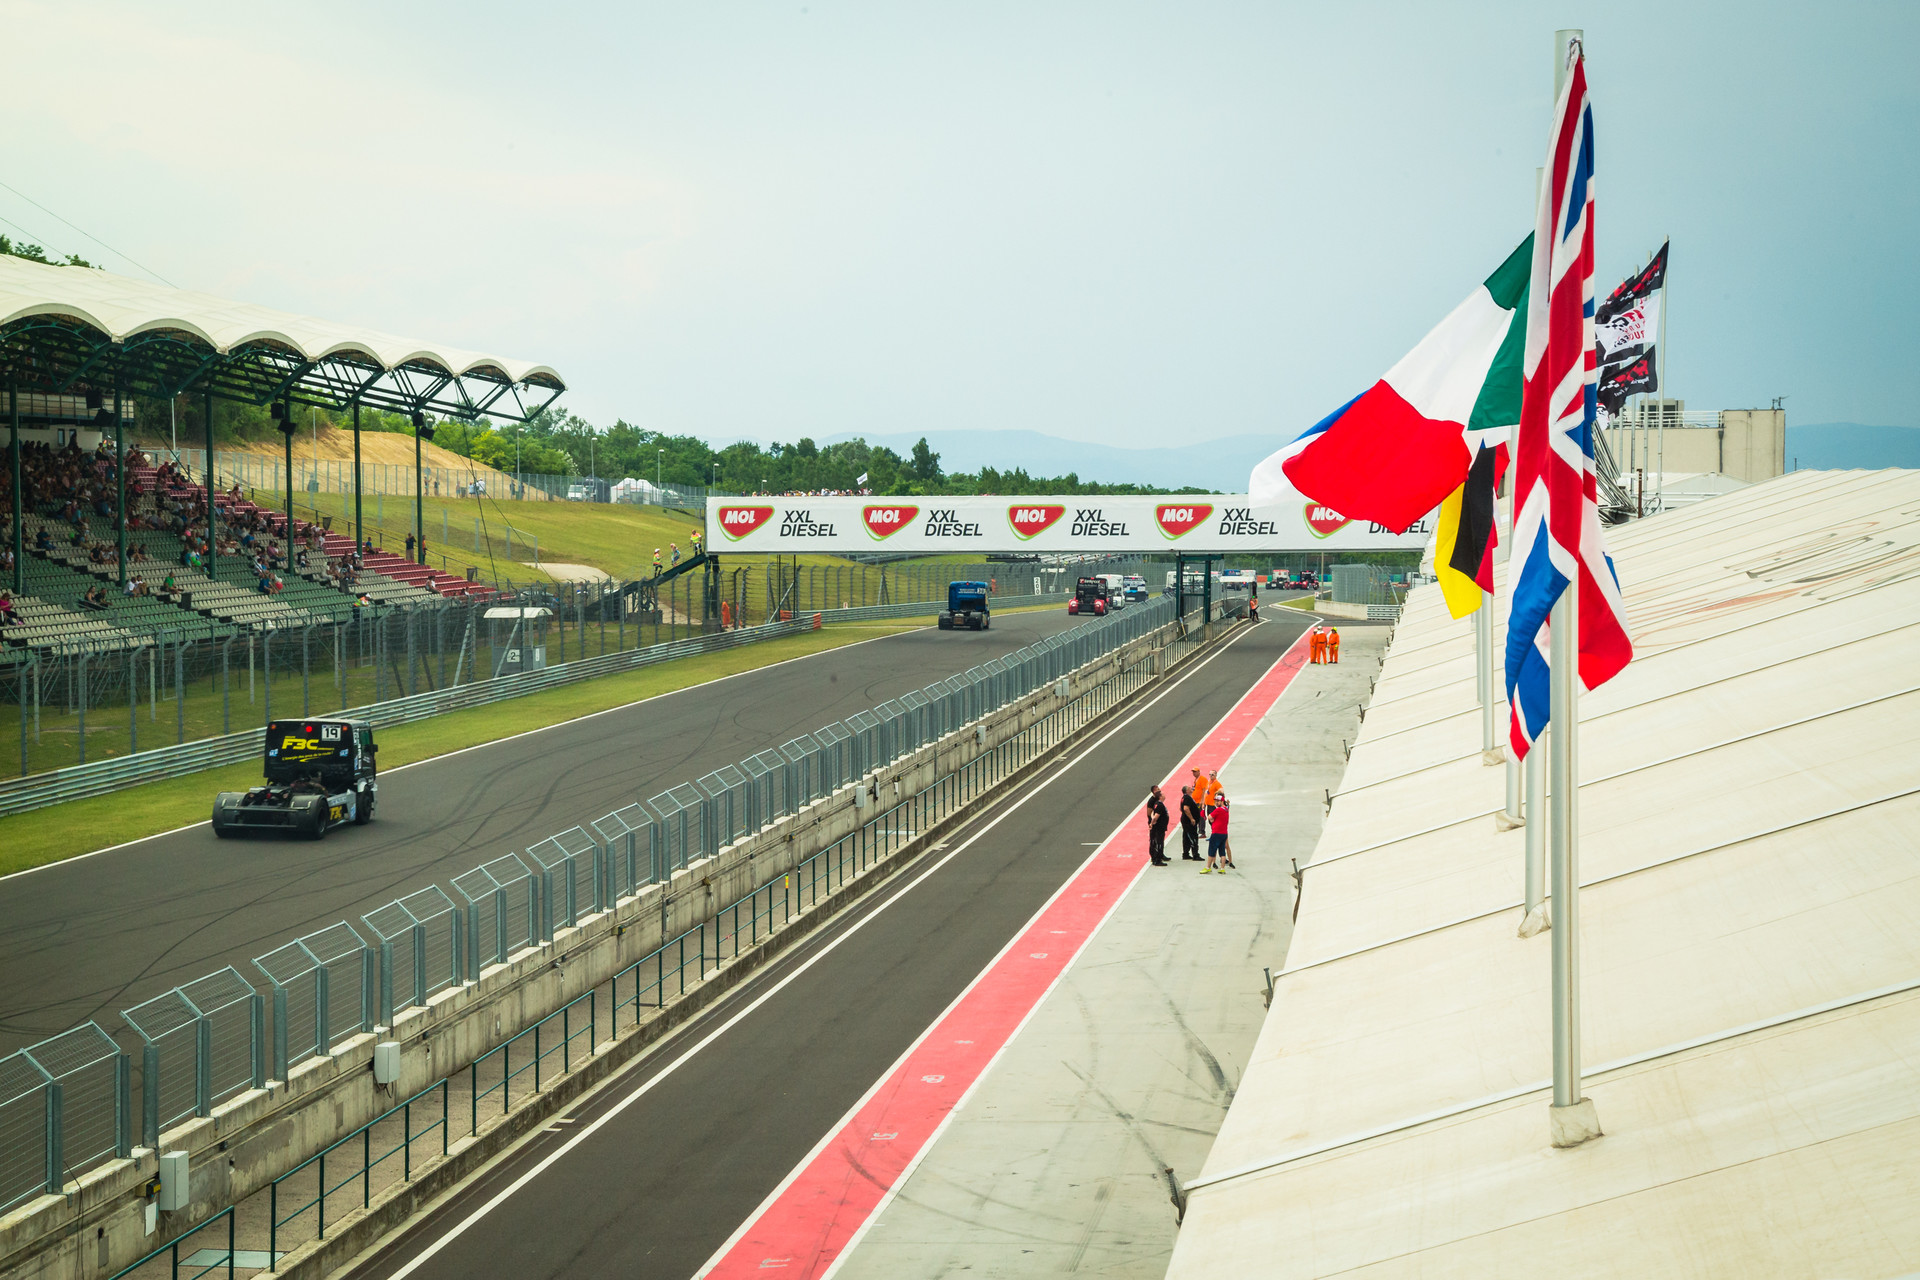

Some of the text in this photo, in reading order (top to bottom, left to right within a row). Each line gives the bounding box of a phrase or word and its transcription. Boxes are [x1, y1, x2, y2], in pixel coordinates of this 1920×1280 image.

[725, 510, 756, 524] MOL
[783, 510, 814, 523] XXL
[869, 510, 900, 523] MOL
[928, 510, 959, 523] XXL
[1015, 509, 1047, 523] MOL
[1074, 509, 1106, 522] XXL
[1162, 508, 1194, 522] MOL
[1222, 508, 1255, 521] XXL
[780, 523, 838, 537] DIESEL
[925, 523, 983, 537] DIESEL
[1071, 522, 1130, 536] DIESEL
[1219, 521, 1279, 535] DIESEL
[1369, 519, 1430, 534] DIEL
[325, 728, 337, 738] 19
[282, 738, 320, 751] F3C
